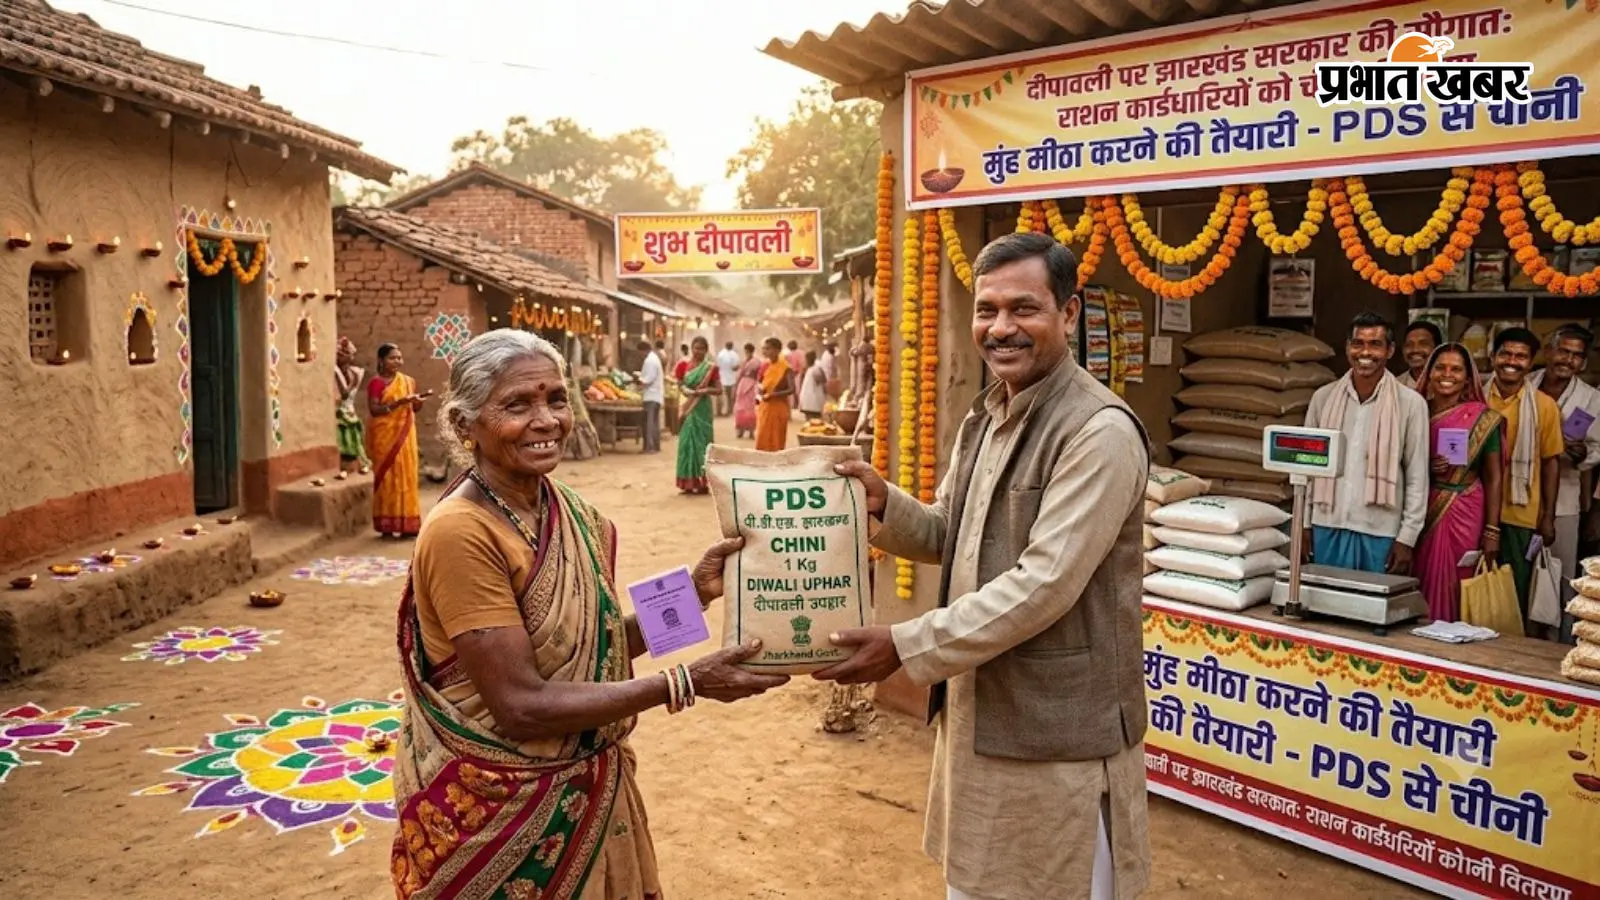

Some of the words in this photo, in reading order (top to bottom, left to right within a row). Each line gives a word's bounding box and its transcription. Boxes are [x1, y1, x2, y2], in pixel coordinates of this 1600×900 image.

[1026, 64, 1111, 101] दीपावली
[1118, 64, 1147, 87] पर
[1153, 45, 1248, 85] झारखंड
[1253, 32, 1351, 67] सरकार
[1357, 19, 1397, 53] की
[1058, 100, 1119, 128] राशन
[1126, 76, 1253, 121] कार्डधारियों
[1257, 72, 1292, 102] को
[983, 145, 1019, 183] मुंह
[1027, 137, 1083, 171] मीठा
[1090, 127, 1157, 164] करने
[1165, 122, 1208, 158] की
[1210, 110, 1298, 153] तैयारी
[1333, 103, 1426, 142] PDS
[1440, 102, 1475, 131] स
[644, 231, 688, 263] शुभ
[695, 220, 792, 254] दीपावली
[766, 486, 826, 510] PDS
[770, 536, 826, 553] CHINI
[784, 559, 791, 571] 1
[797, 559, 817, 573] Kg
[747, 579, 797, 592] DIWALI
[803, 576, 851, 590] UPHAR
[1144, 645, 1180, 690] मुंह
[1186, 655, 1249, 702] मीठा
[1255, 681, 1332, 724] करने
[1339, 692, 1384, 738] की
[1390, 699, 1497, 767] तैयारी
[1150, 695, 1186, 736] की
[1191, 702, 1277, 764] तैयारी
[1311, 743, 1391, 798] PDS
[1402, 764, 1442, 813] से
[1448, 778, 1548, 845] चीनी
